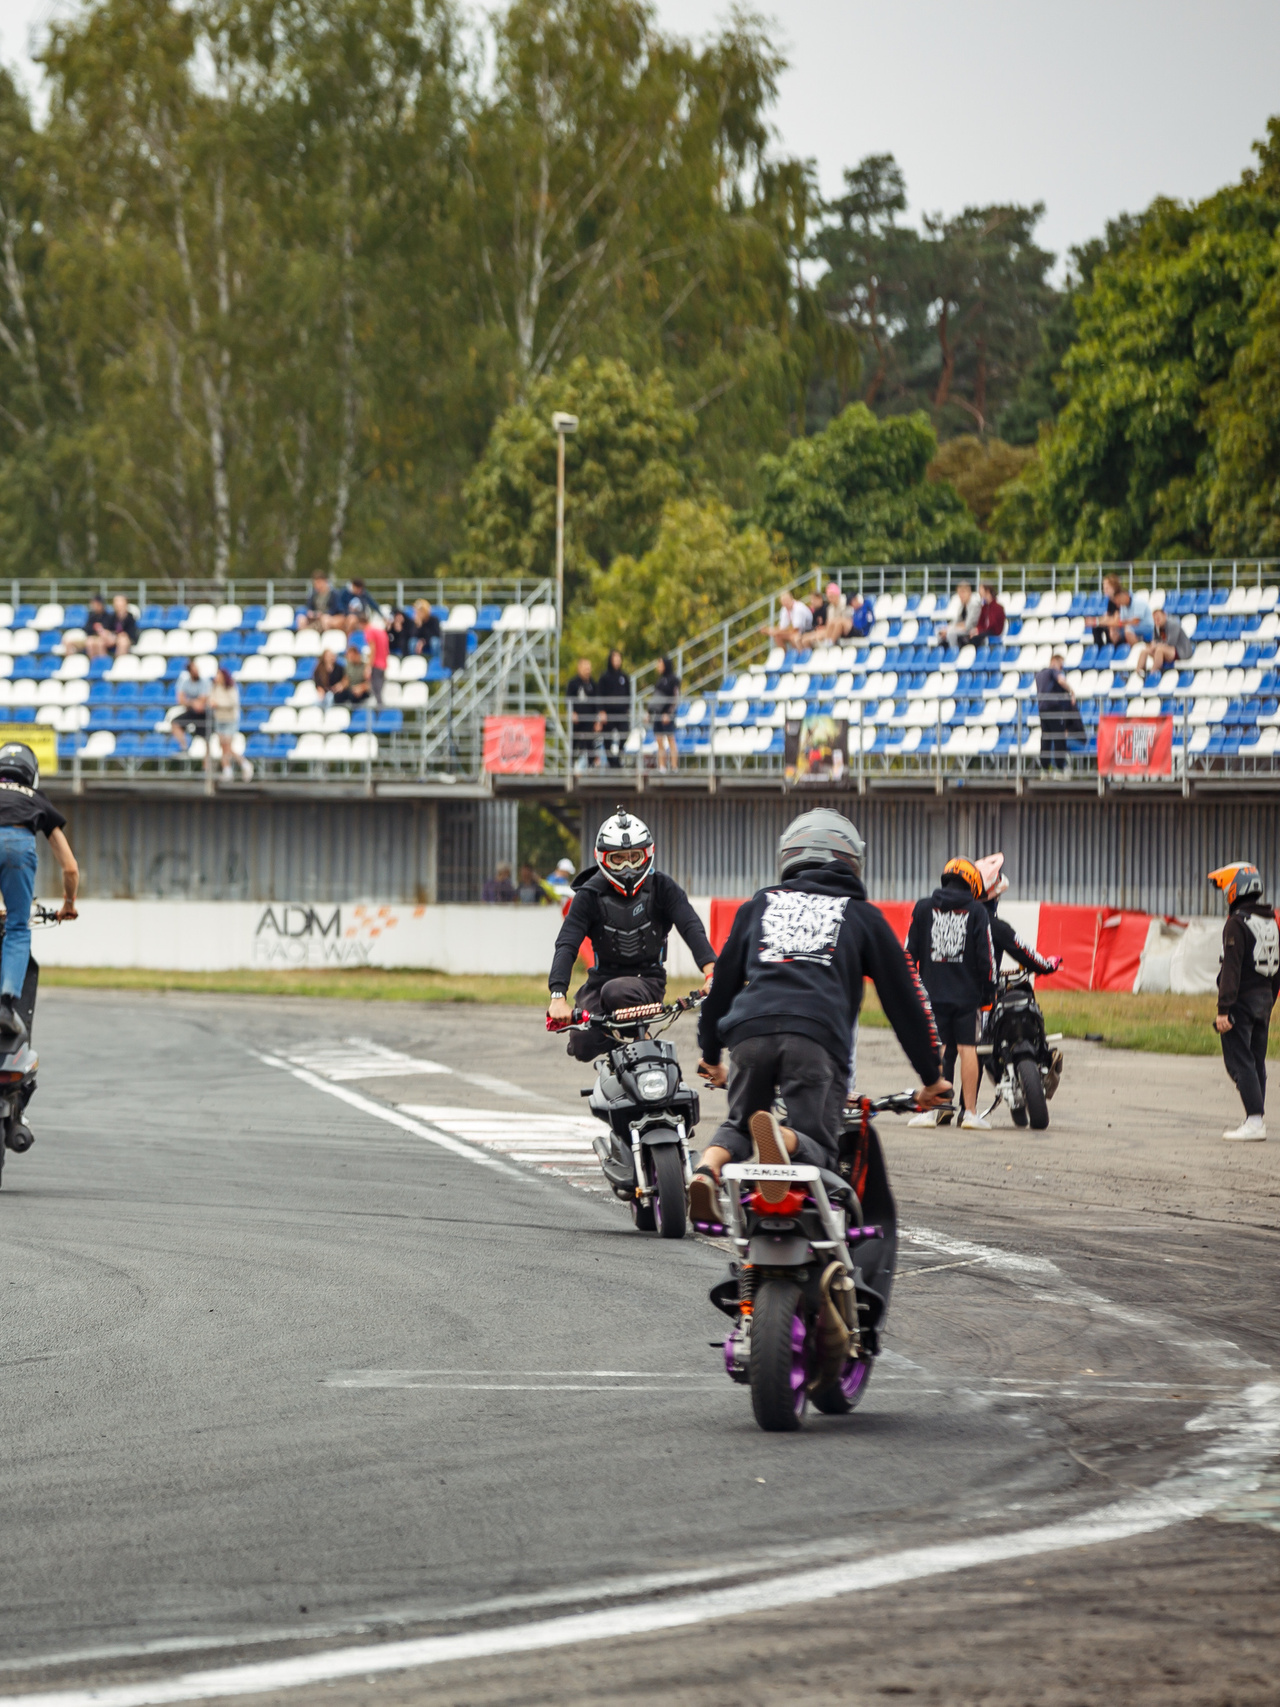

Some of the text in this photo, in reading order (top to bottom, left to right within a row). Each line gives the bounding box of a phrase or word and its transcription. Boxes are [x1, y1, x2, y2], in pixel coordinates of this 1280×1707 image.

[255, 904, 341, 937] ADM
[253, 939, 376, 963] RACEWAY
[743, 1167, 798, 1177] YAMAHA
